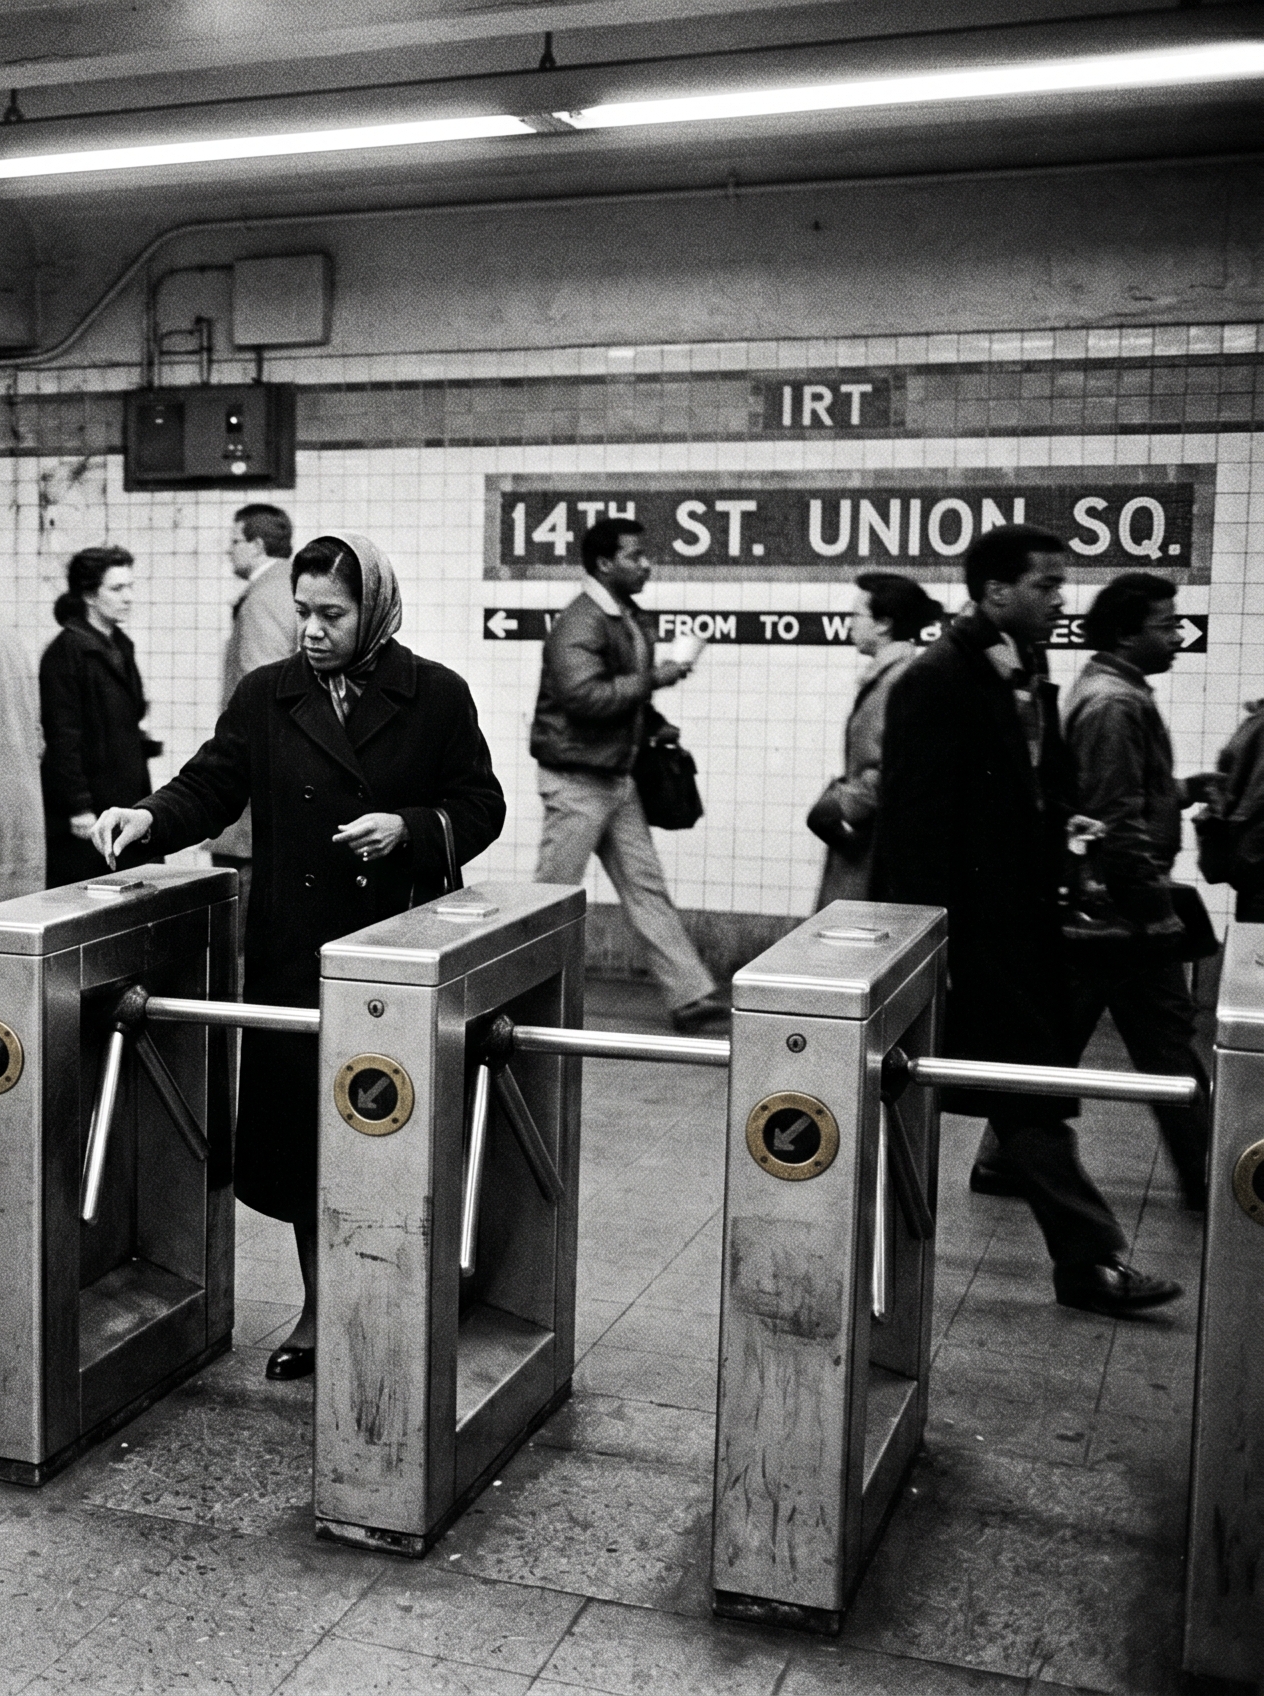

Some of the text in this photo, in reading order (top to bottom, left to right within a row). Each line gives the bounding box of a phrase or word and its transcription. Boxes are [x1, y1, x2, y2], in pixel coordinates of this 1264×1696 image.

[782, 383, 873, 427] IRT
[672, 500, 765, 557] ST.
[1068, 496, 1181, 560] SQ.
[658, 614, 737, 640] FROM
[760, 615, 800, 641] TO
